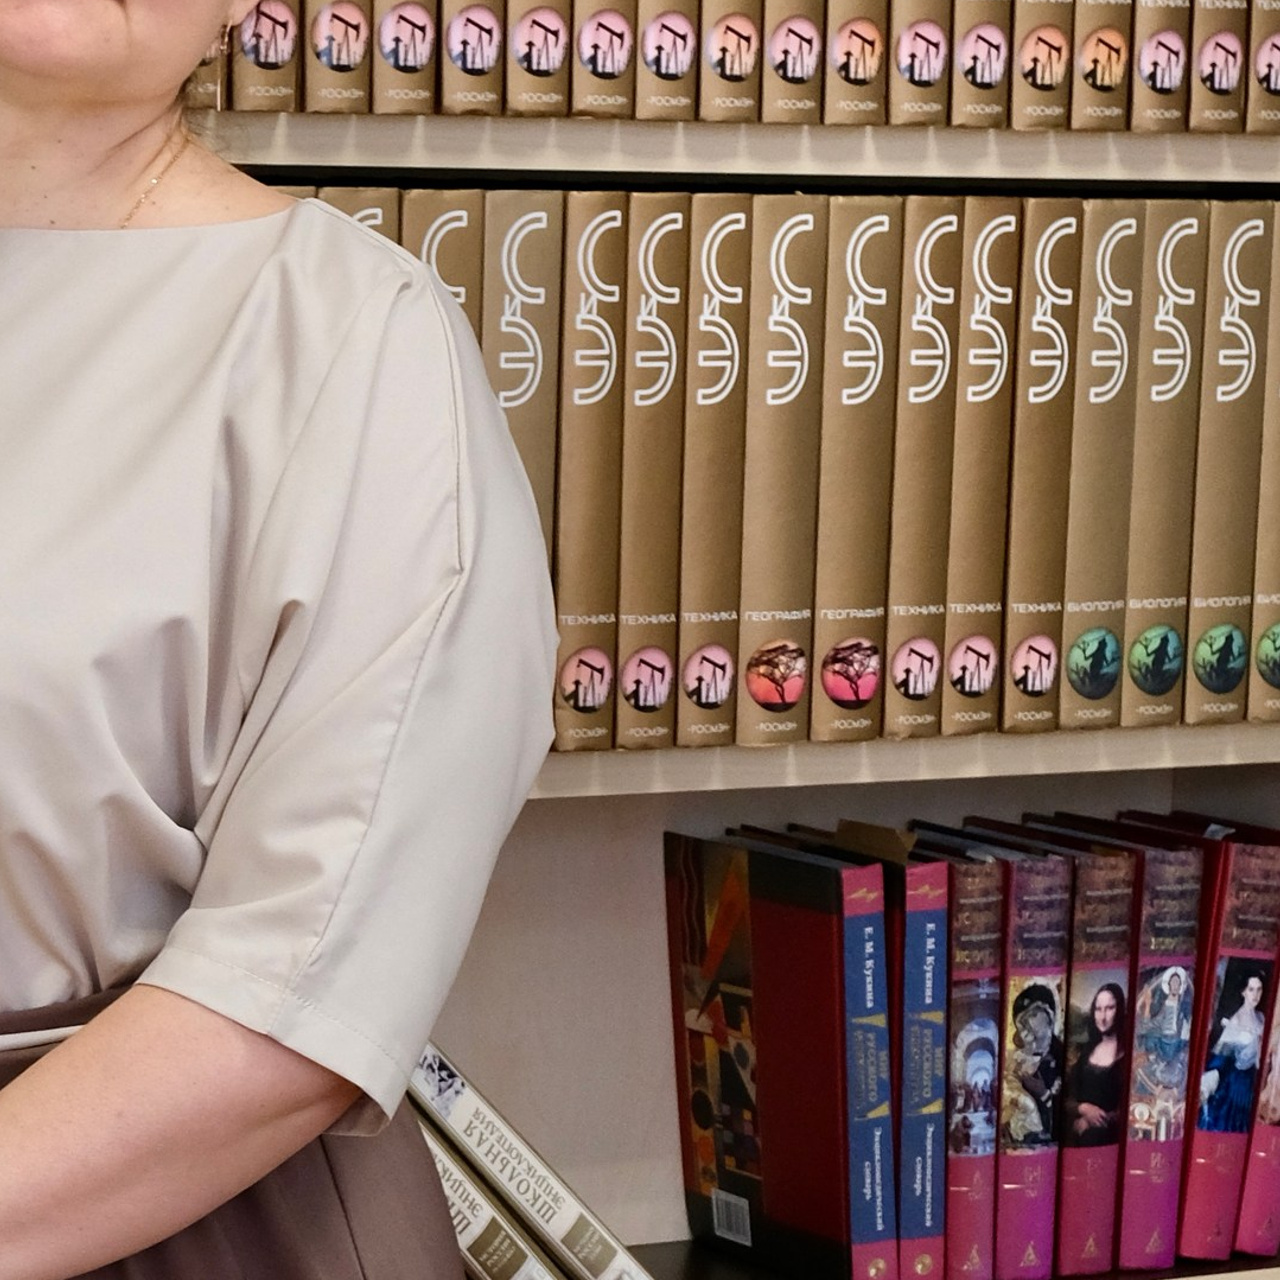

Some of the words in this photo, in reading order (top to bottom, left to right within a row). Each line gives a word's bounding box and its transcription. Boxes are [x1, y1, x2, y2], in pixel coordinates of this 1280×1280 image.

[1067, 600, 1125, 612] БИОЛОГИЯ
[1129, 597, 1186, 609] БИОЛОГИЯ
[1194, 595, 1251, 607] БИОЛОГИЯ
[820, 607, 884, 620] ГЕОГРАФИЯ
[893, 605, 944, 616] ТЕХНИКА
[950, 603, 1002, 614] ТЕХНИКА
[1012, 603, 1061, 613] ТЕХНИКА
[560, 614, 616, 626] ТЕХНИКА
[621, 614, 676, 625] ТЕХНИКА
[683, 611, 737, 623] ТЕХНИКА
[744, 610, 811, 622] ГЕОГРАФИЯ
[864, 960, 875, 1008] Кукина
[923, 956, 935, 1004] Кукина
[473, 1107, 566, 1210] ЭНЦИКЛОПЕДИЯ
[463, 1120, 557, 1224] ШКОЛЬНАЯ
